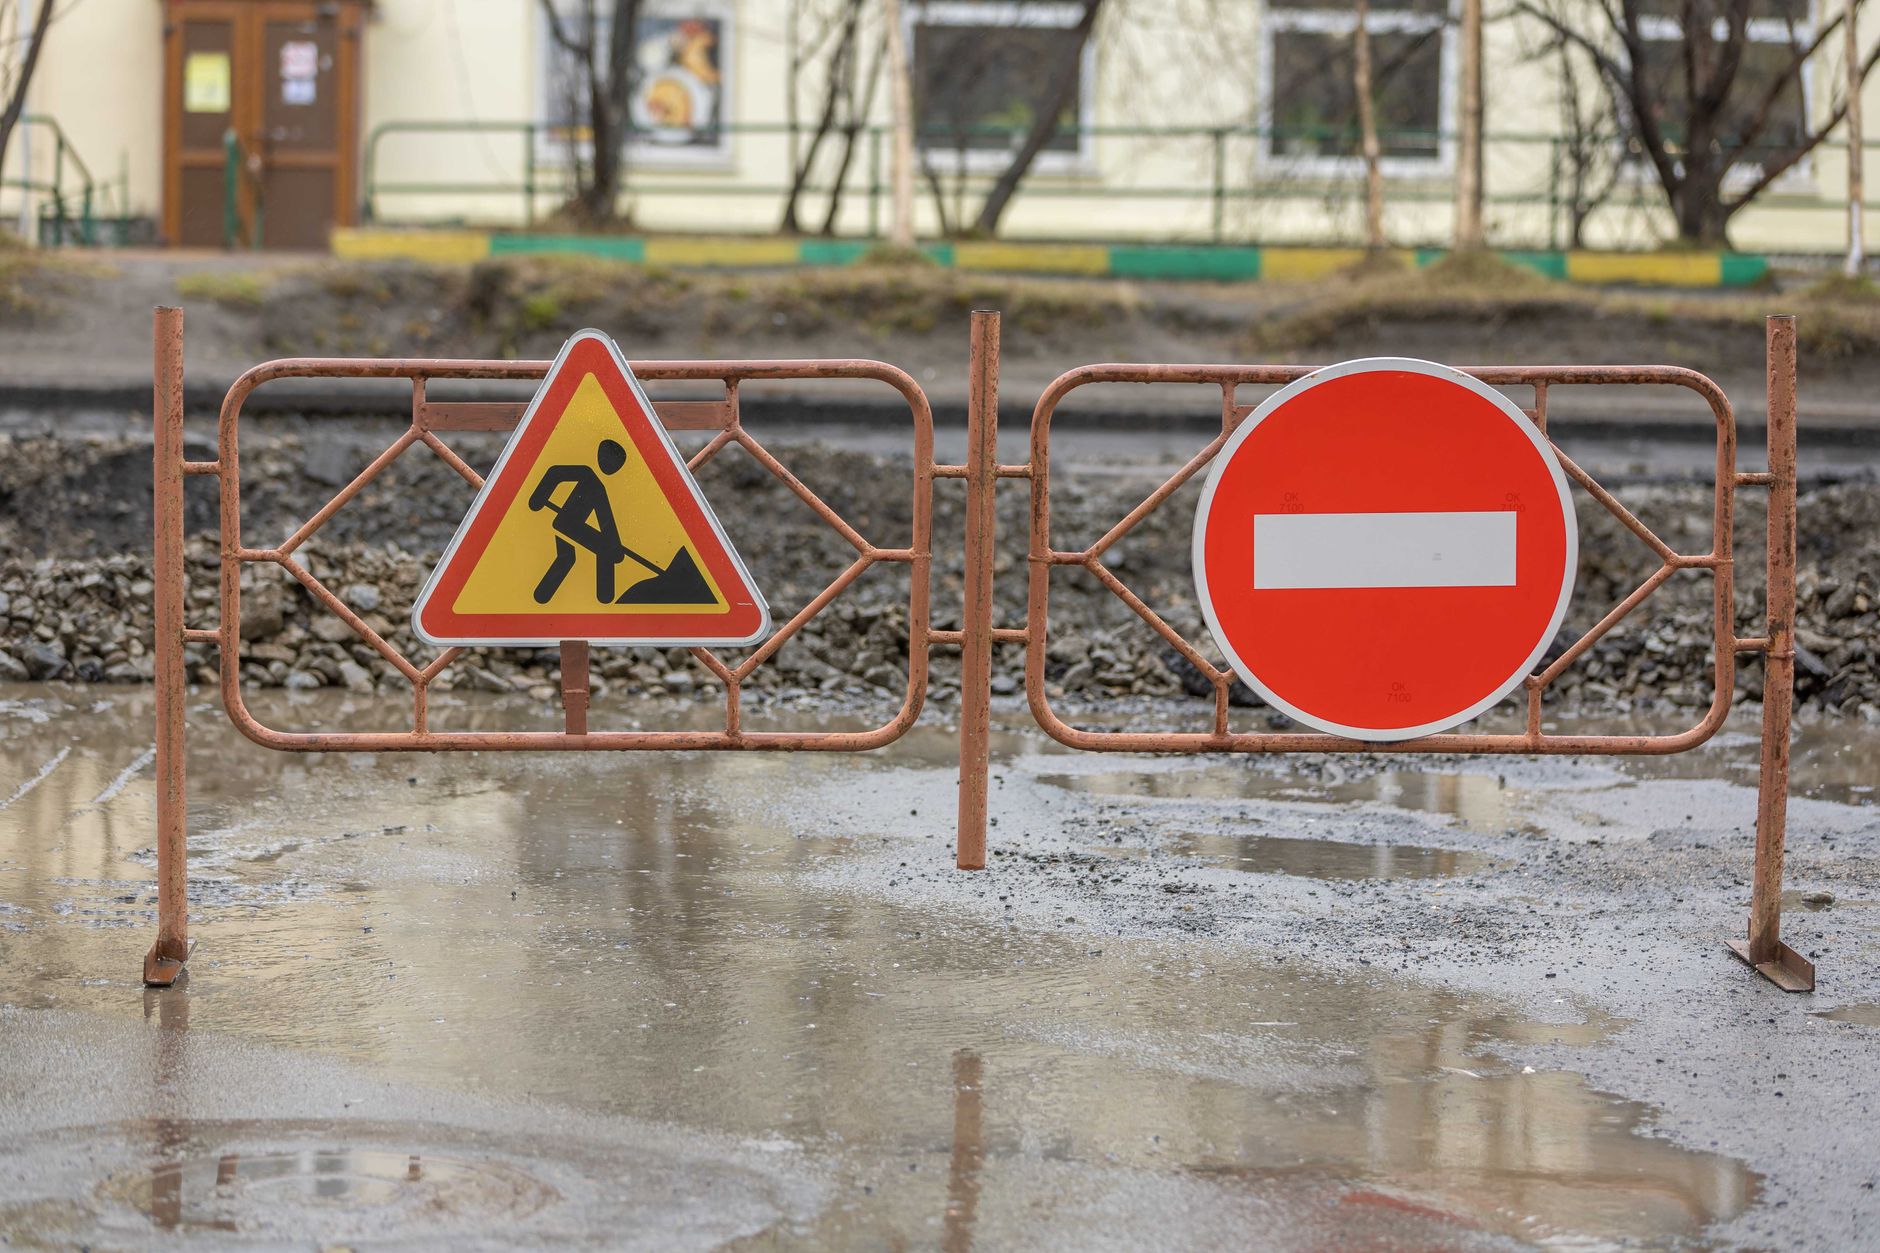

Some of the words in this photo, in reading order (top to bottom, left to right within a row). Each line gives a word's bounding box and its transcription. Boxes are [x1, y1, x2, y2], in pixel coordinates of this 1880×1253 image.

[1284, 491, 1299, 502] OK
[1505, 492, 1521, 503] OK
[1391, 681, 1406, 692] OK
[1386, 692, 1412, 703] 7100
